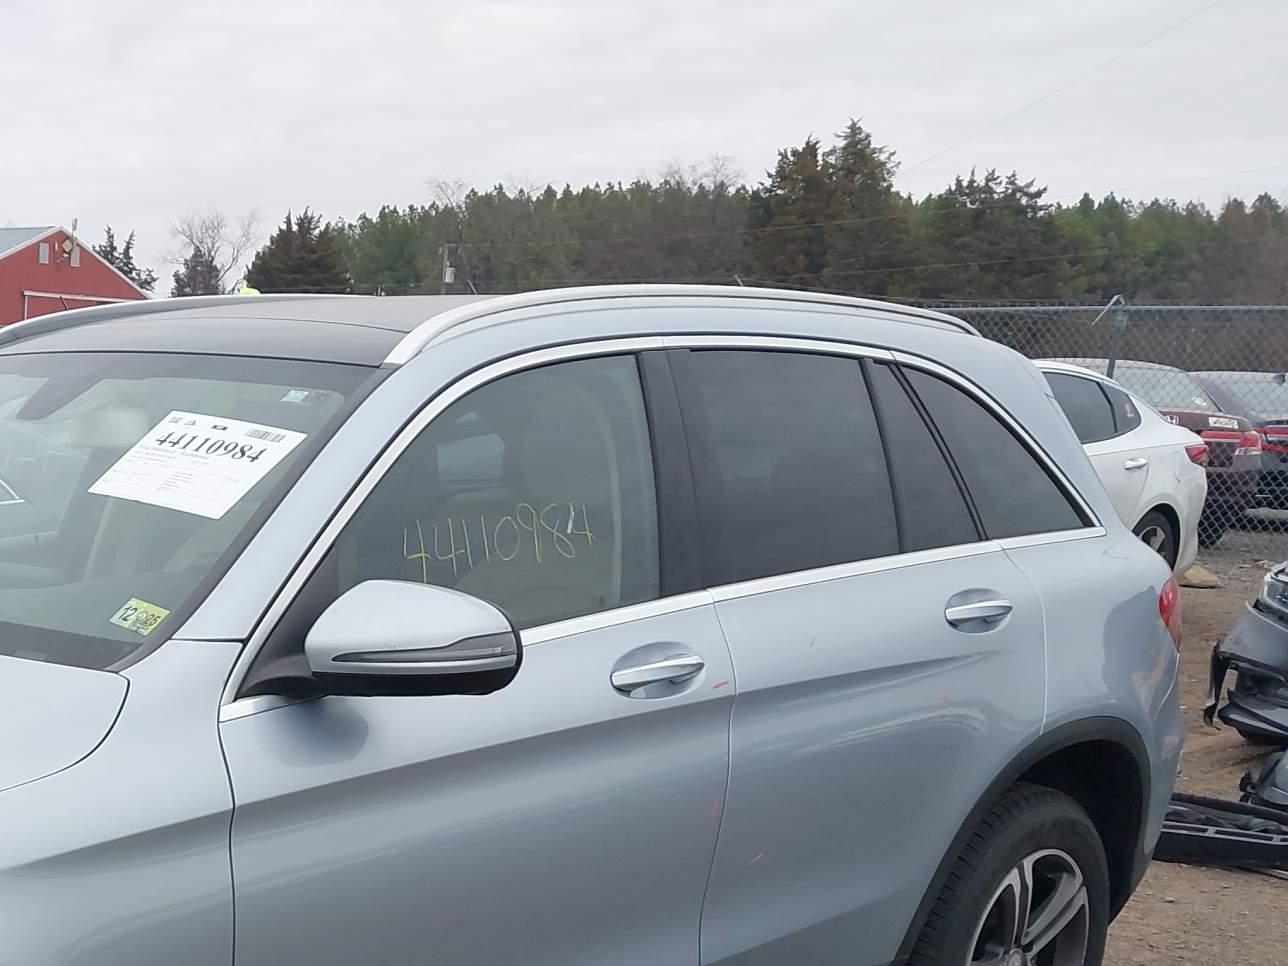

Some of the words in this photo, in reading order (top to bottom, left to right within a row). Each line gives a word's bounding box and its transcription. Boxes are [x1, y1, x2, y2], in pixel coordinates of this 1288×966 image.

[156, 431, 268, 463] 44110984
[401, 501, 596, 584] 44110984
[118, 606, 138, 622] 12
